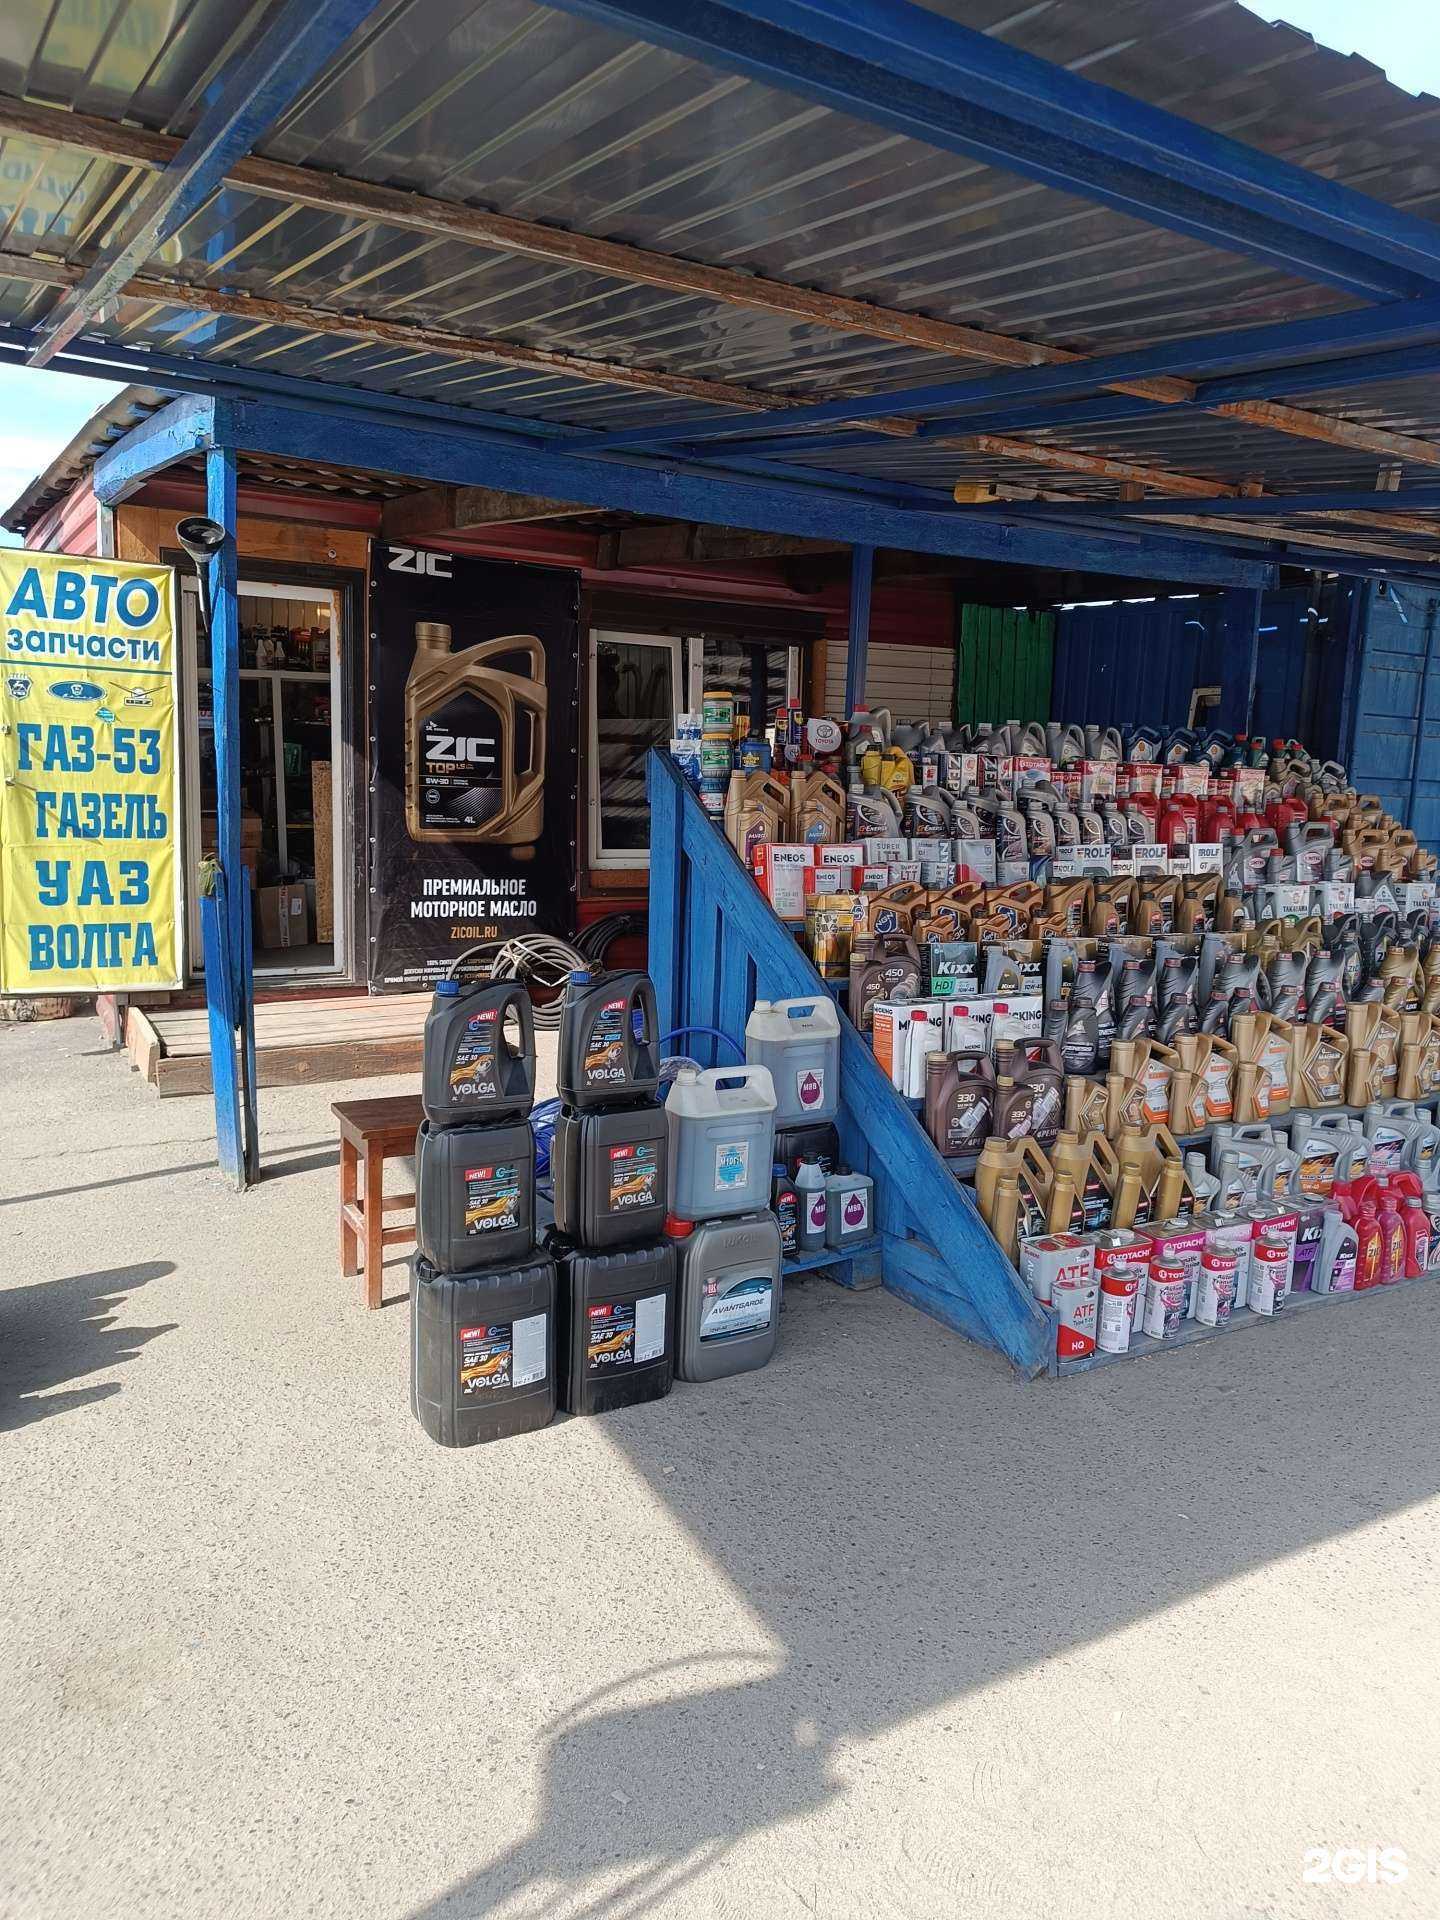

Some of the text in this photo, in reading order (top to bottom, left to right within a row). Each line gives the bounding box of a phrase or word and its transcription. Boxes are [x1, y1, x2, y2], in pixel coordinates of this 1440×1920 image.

[388, 546, 453, 578] ZIC
[5, 567, 160, 628] АВТО
[7, 628, 160, 661] запчасти
[17, 723, 161, 775] ГАЗ-53
[425, 734, 495, 763] ZIC
[425, 762, 456, 774] TOP
[425, 777, 449, 785] 5W-30
[36, 791, 168, 839] ГАЗЕЛЬ
[773, 853, 806, 862] ENEOS
[823, 854, 855, 863] ENEOS
[1083, 847, 1110, 858] ROLF
[1142, 847, 1167, 858] ROLF
[36, 860, 150, 906] УАЗ
[423, 878, 527, 896] ПРЕМИАЛЬНОЕ
[411, 900, 537, 918] МОТОРНОЕ МАСЛО
[450, 926, 498, 939] ZICOIL.RU
[28, 922, 158, 970] ВОЛГА
[885, 968, 904, 977] 450
[937, 961, 975, 975] Kixx
[934, 979, 954, 991] HD1
[477, 1011, 496, 1020] NEW!
[587, 1067, 626, 1080] VOLGA
[453, 1082, 496, 1095] VOLGA
[956, 1093, 976, 1103] 330
[469, 1170, 486, 1179] NEW!
[618, 1190, 653, 1205] VOLGA
[474, 1214, 515, 1230] VOLGA
[1056, 1263, 1090, 1281] ATF
[591, 1307, 607, 1316] NEW!
[711, 1298, 765, 1316] AVANTGARDE
[1073, 1303, 1095, 1318] ATF
[463, 1329, 481, 1339] NEW!
[604, 1331, 614, 1339] 30
[1071, 1340, 1085, 1351] HQ
[464, 1354, 489, 1364] SAE 30
[593, 1349, 632, 1364] VOLGA
[468, 1372, 510, 1389] VOLGA
